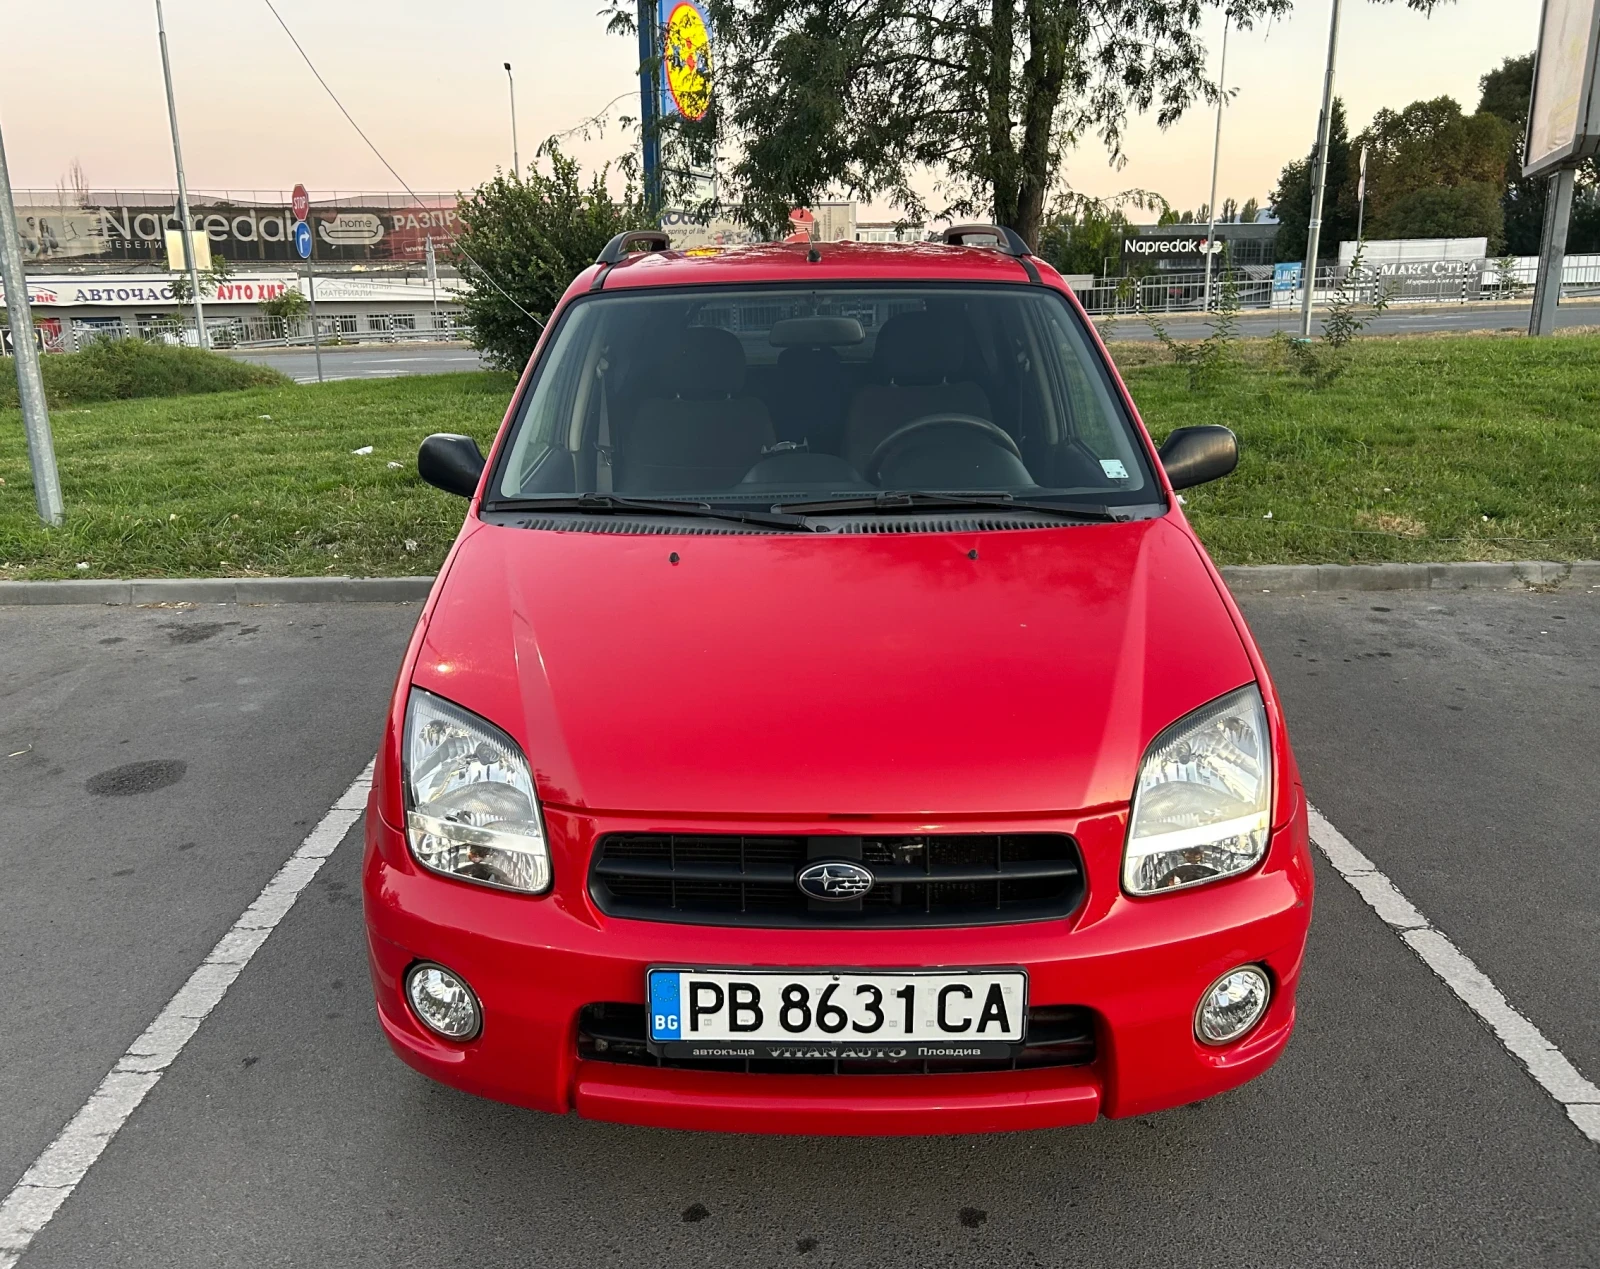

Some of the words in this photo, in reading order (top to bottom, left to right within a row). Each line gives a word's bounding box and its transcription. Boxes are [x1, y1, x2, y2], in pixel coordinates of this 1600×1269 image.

[293, 197, 306, 210] STOP
[340, 217, 373, 228] home
[668, 228, 687, 236] spring
[104, 240, 162, 249] МЕБЕЛИ
[1124, 239, 1198, 256] Napredak
[74, 287, 193, 302] АВТОЧАС
[217, 284, 254, 300] АУТО
[689, 981, 764, 1033] PB
[779, 982, 915, 1034] 8631
[936, 983, 1011, 1033] CA
[654, 1015, 679, 1031] BG
[693, 1047, 755, 1057] автокъща
[766, 1046, 838, 1058] VITAN
[840, 1046, 907, 1058] AUTO
[918, 1047, 981, 1057] Пловдив
